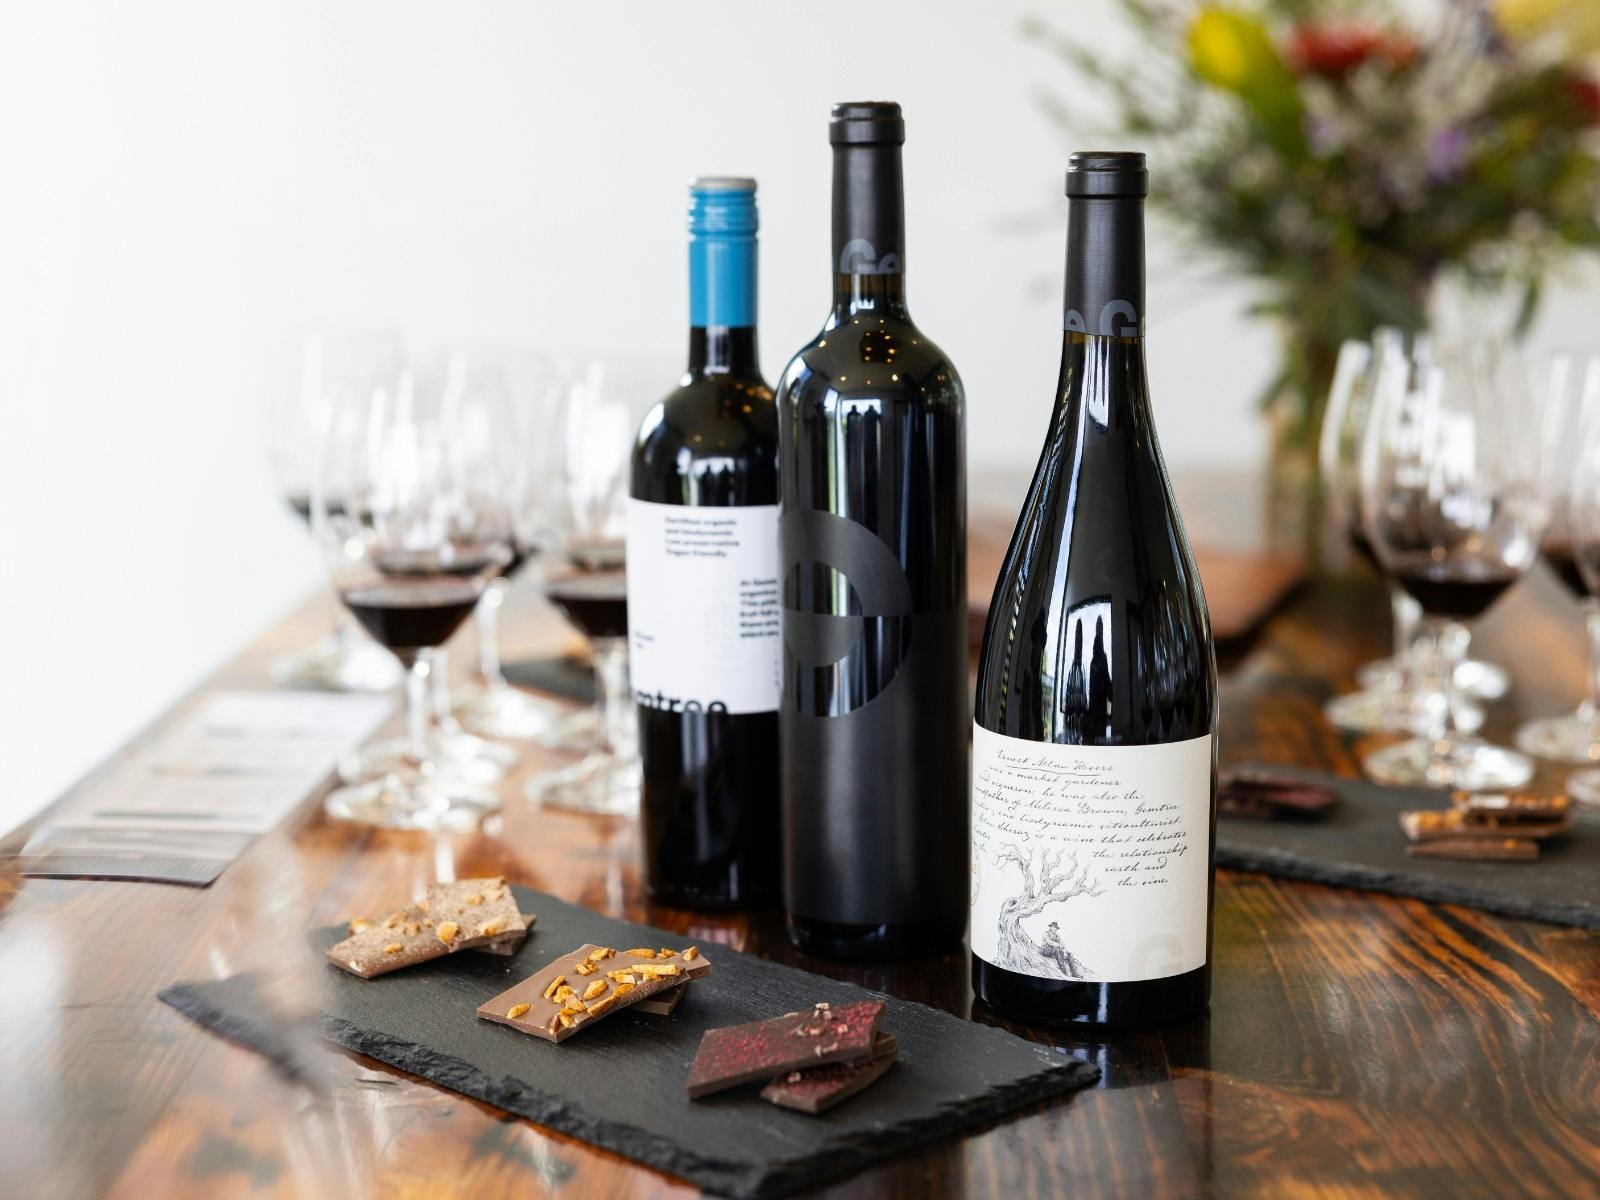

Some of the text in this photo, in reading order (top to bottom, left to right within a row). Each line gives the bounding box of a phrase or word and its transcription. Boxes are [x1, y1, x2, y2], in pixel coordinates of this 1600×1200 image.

[1099, 299, 1144, 337] G
[997, 749, 1030, 764] Ernest
[1017, 773, 1061, 784] market
[1061, 778, 1122, 792] gardener
[1042, 787, 1056, 797] he
[1092, 790, 1120, 800] also
[1123, 789, 1145, 800] the
[1007, 799, 1022, 812] of
[1019, 813, 1095, 831] biodynamic
[998, 821, 1031, 842] Shiraz
[1063, 833, 1095, 842] wine
[1100, 833, 1133, 844] that
[1136, 831, 1188, 844] celebrates
[1091, 842, 1189, 859] the relationship
[1105, 855, 1168, 873] earth and
[1115, 876, 1138, 887] the
